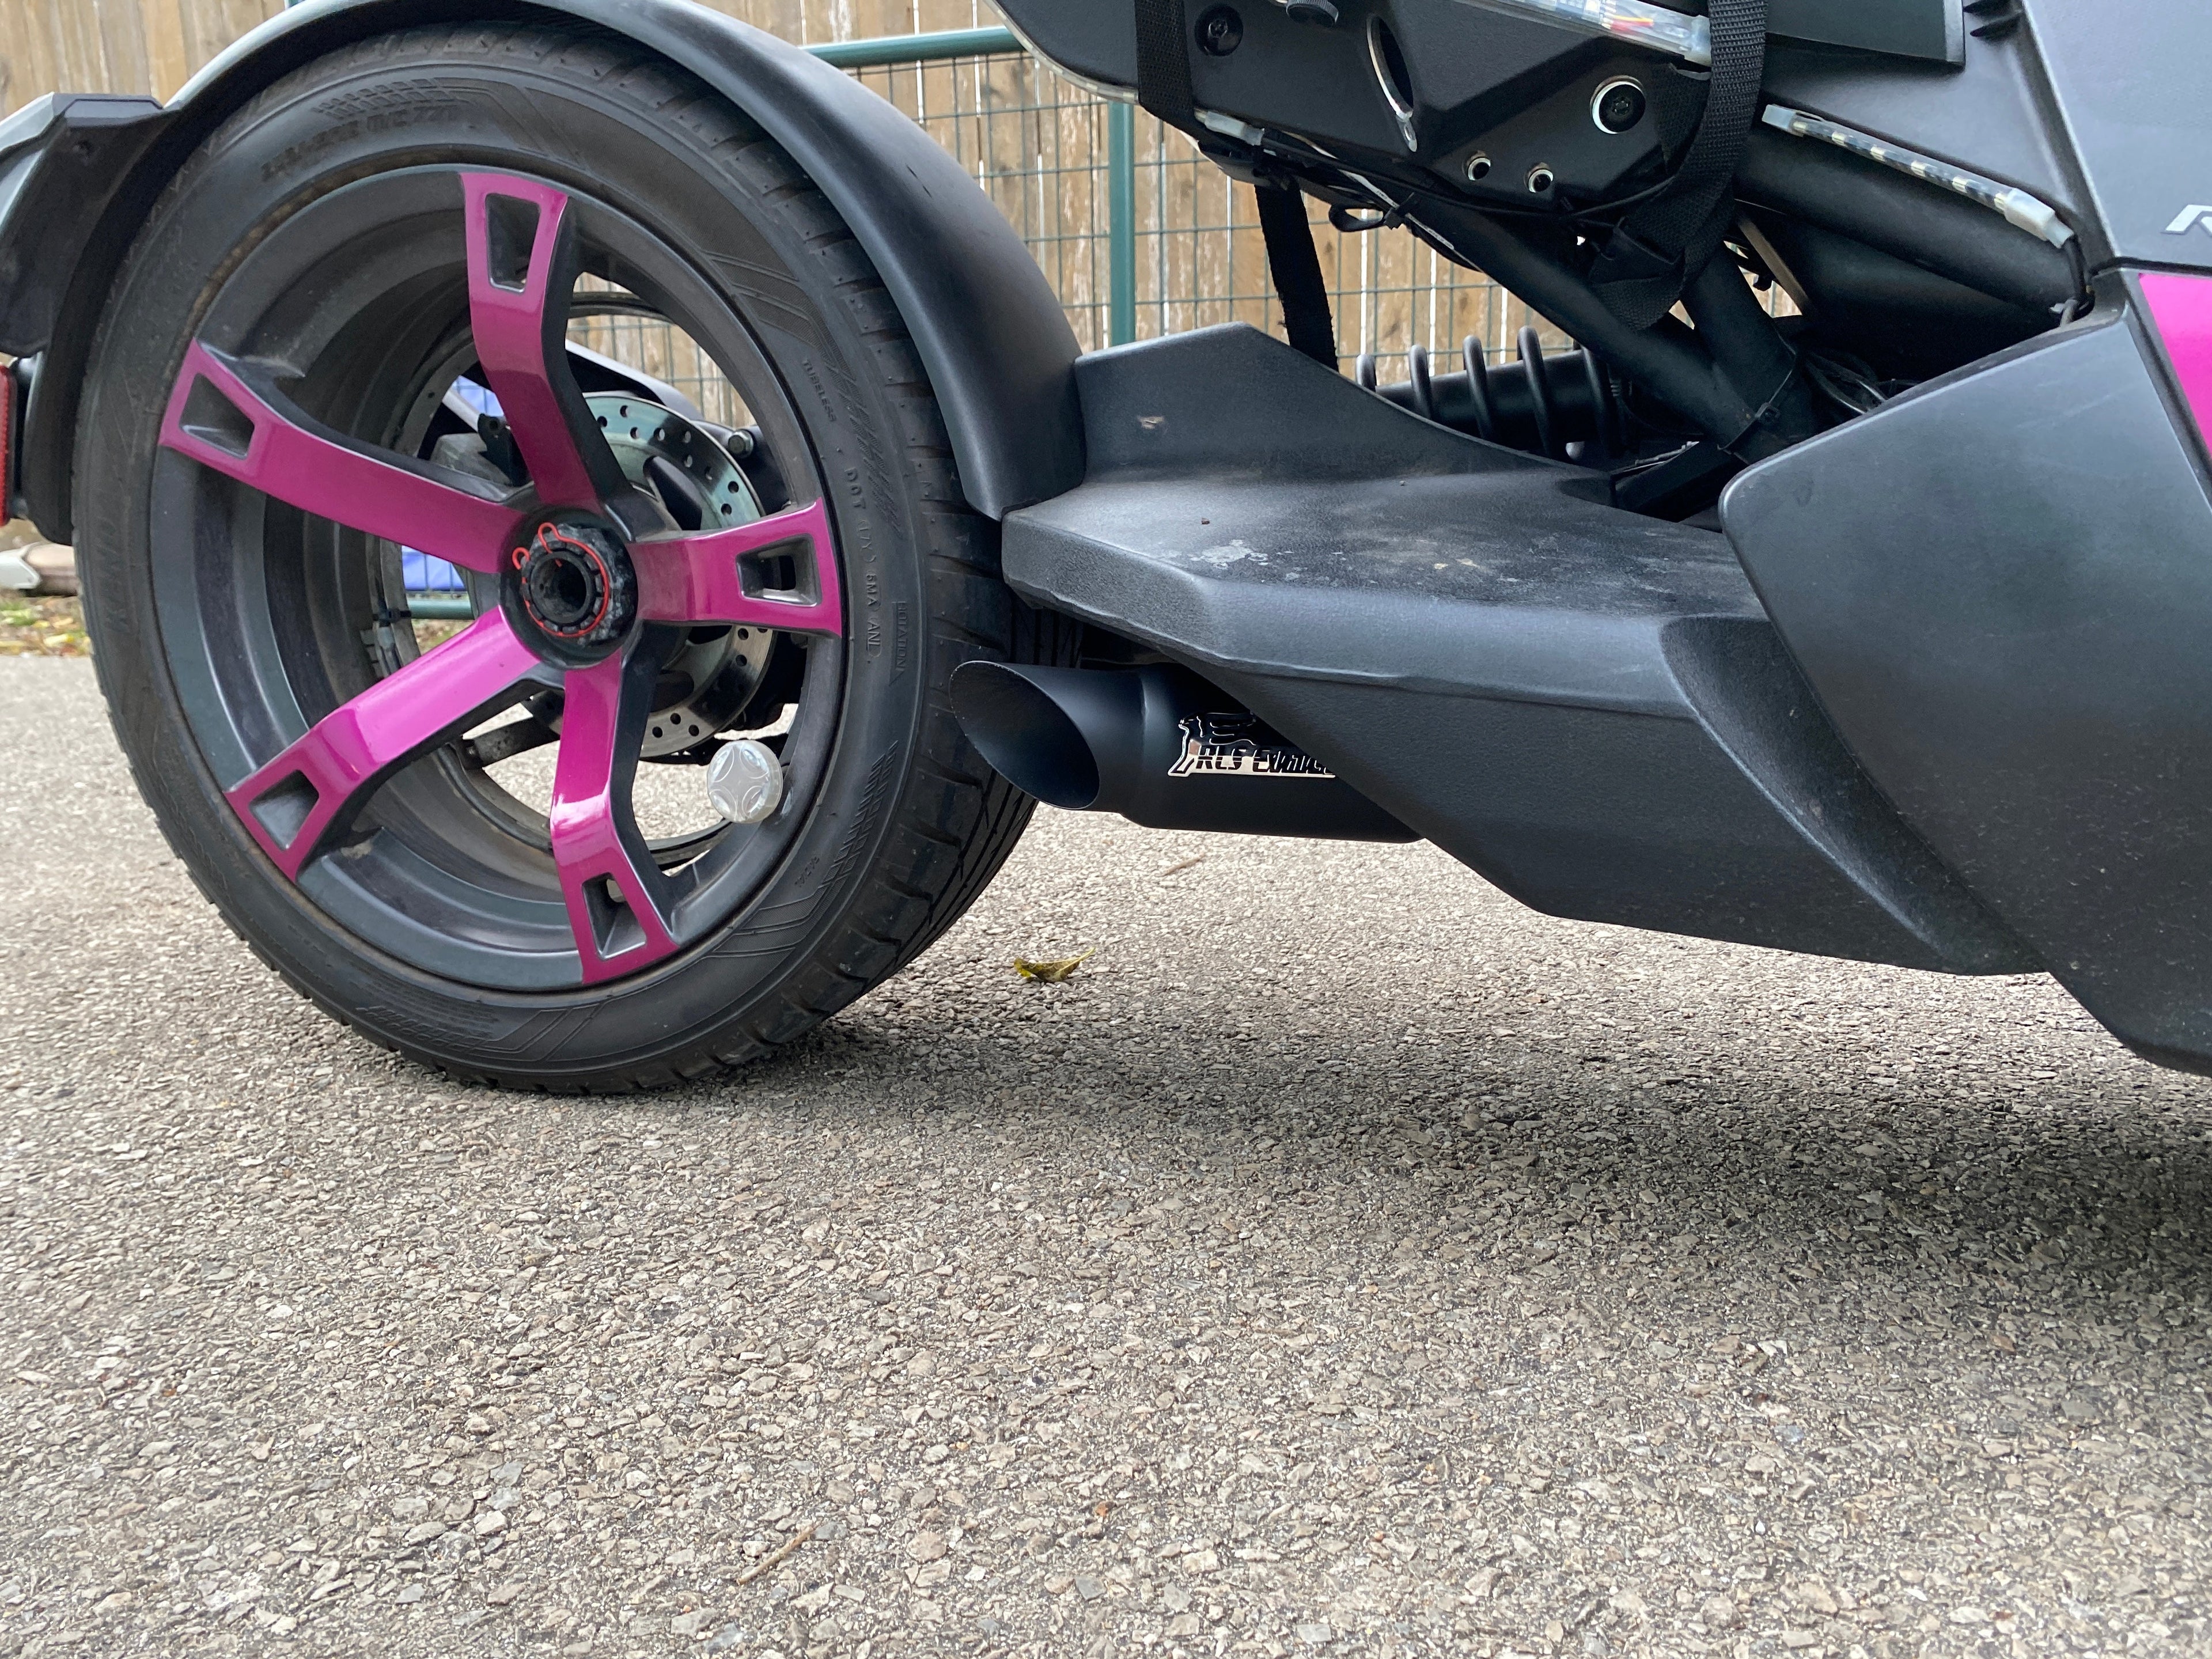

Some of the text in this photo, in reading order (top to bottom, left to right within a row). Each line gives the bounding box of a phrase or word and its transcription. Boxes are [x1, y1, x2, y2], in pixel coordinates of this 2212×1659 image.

[801, 359, 837, 422] TUBELESS
[844, 467, 865, 509] DOT
[896, 603, 908, 669] ROTATION
[794, 856, 820, 888] RADIAL
